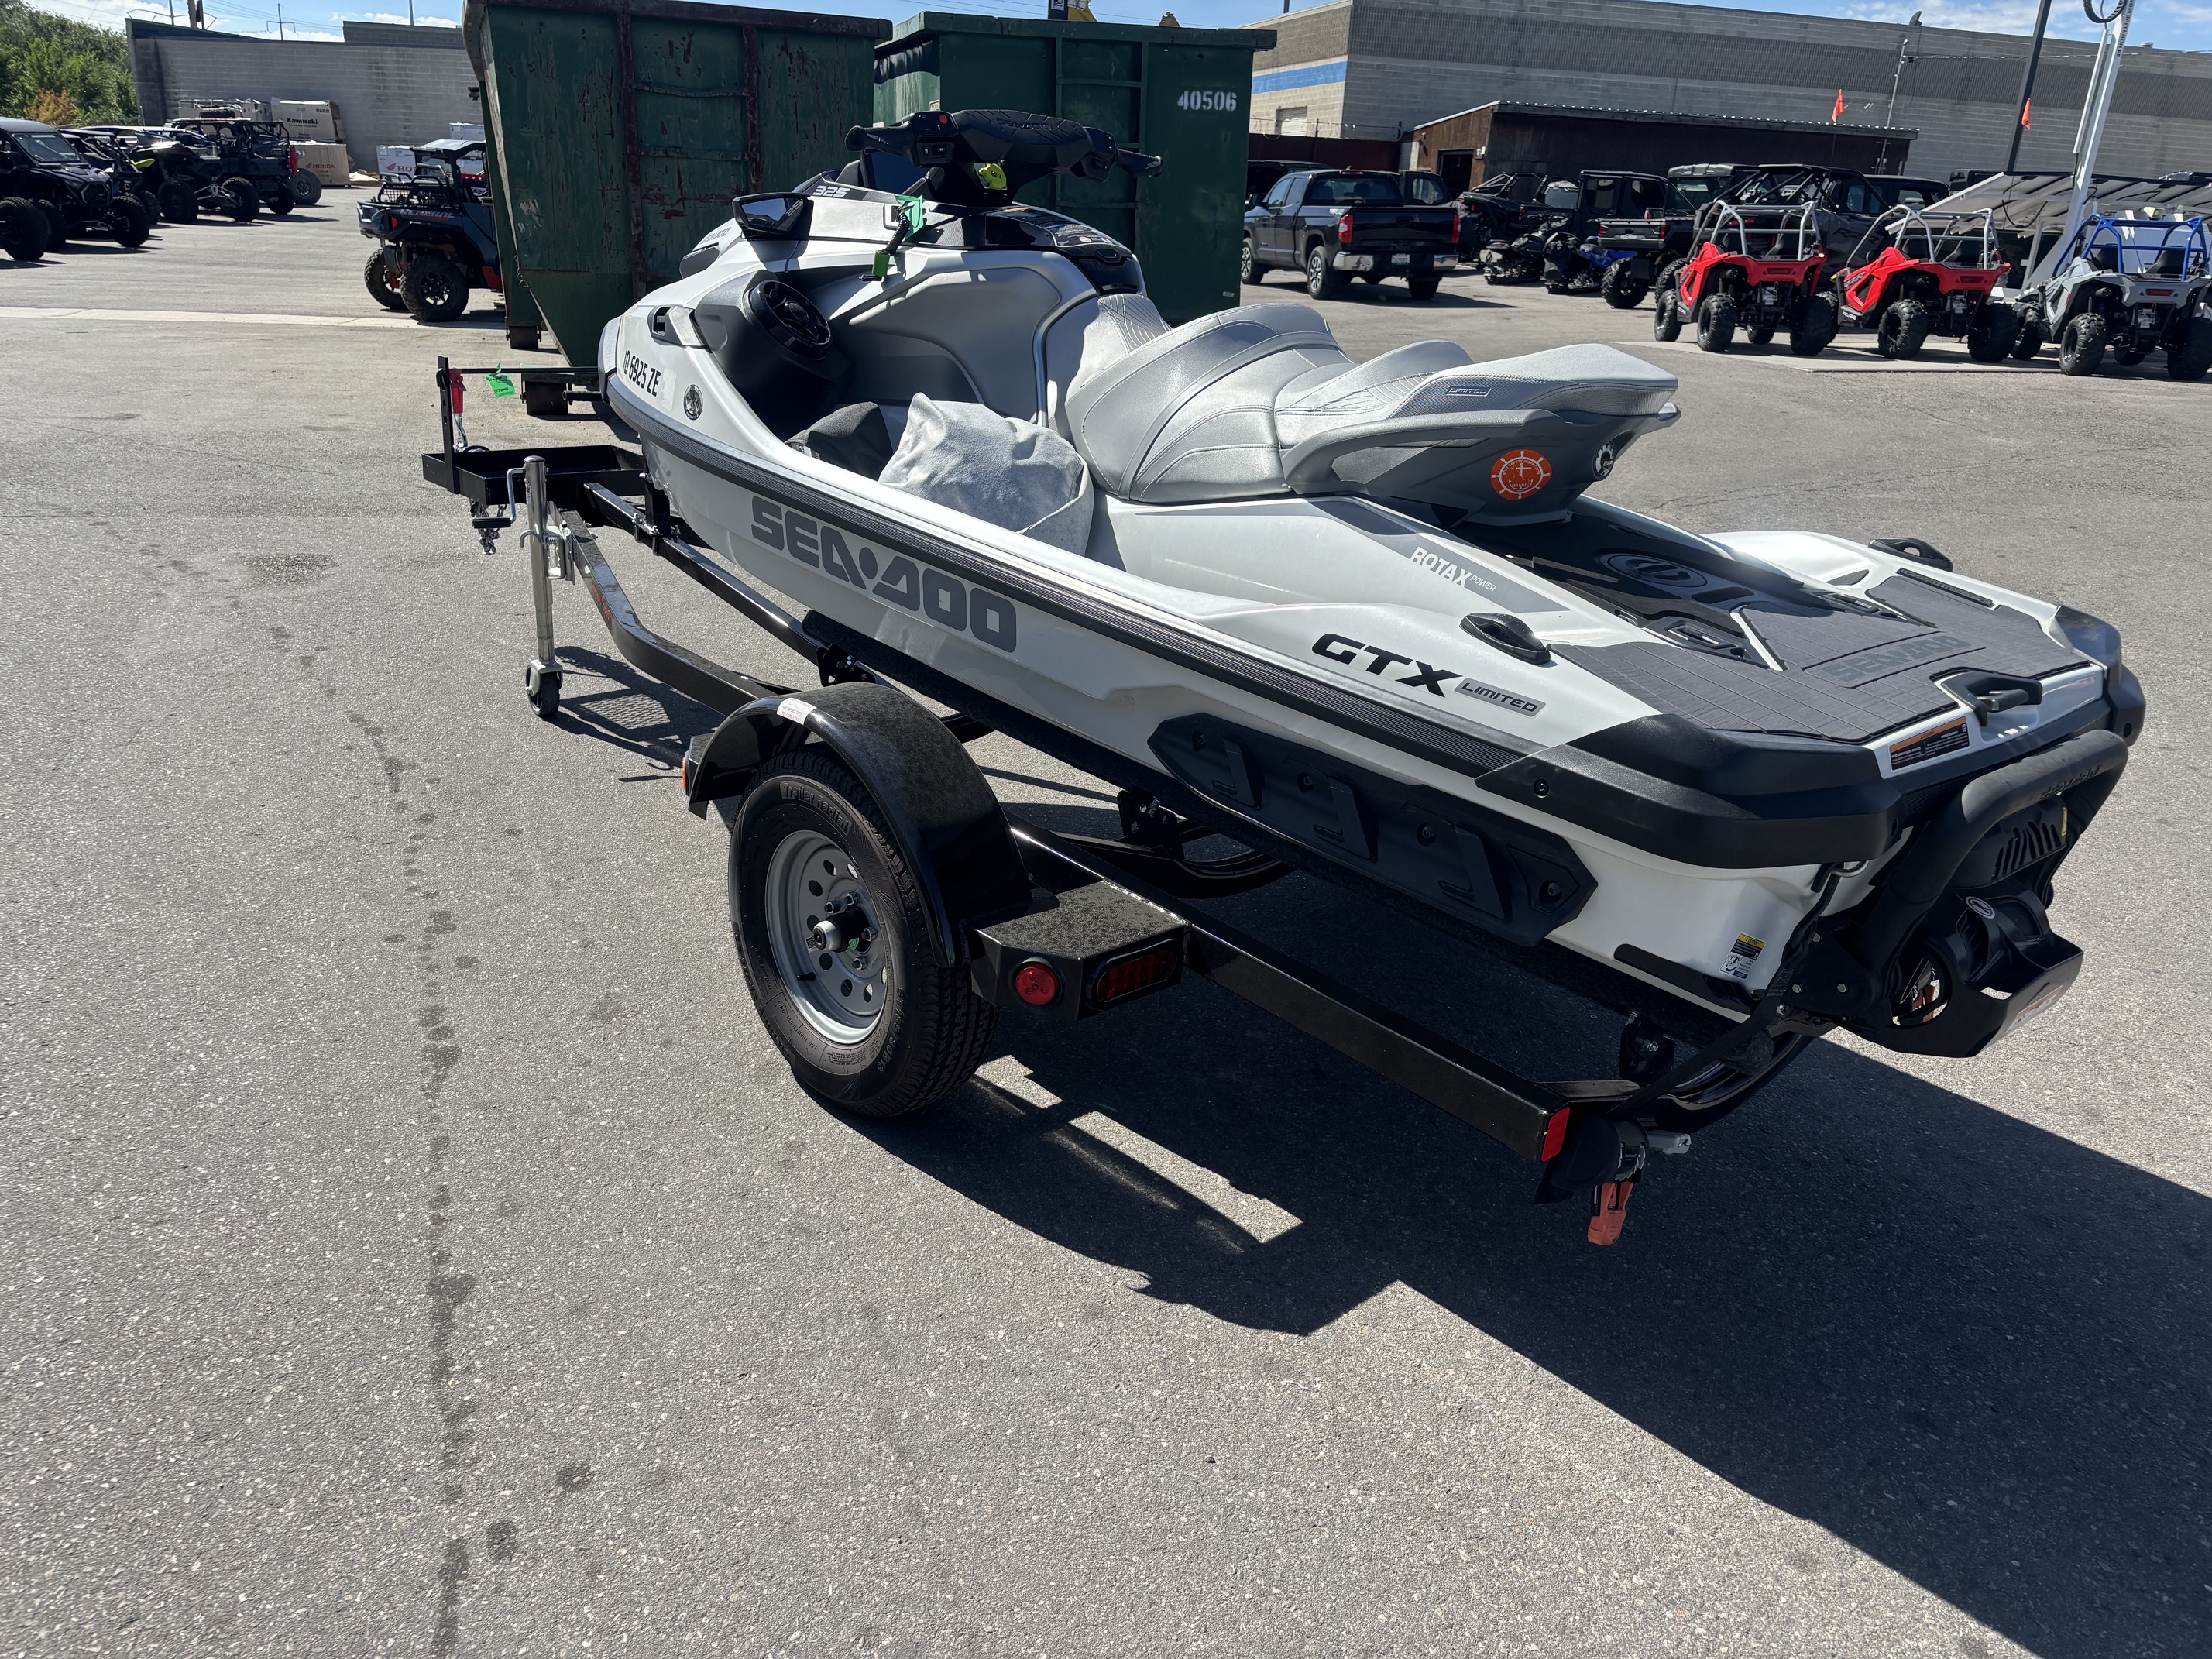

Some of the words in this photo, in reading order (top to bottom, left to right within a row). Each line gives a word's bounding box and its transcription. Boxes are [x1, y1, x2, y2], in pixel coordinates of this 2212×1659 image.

[2119, 29, 2128, 48] HOUR
[1177, 91, 1238, 112] 40506
[812, 185, 851, 198] 325
[399, 208, 455, 218] GENERAL
[623, 349, 630, 375] ID
[629, 355, 648, 390] 6925
[646, 367, 661, 397] ZE
[1523, 459, 1540, 475] INSPECTION
[1410, 546, 1473, 588] ROTAX
[1470, 575, 1497, 592] POWER
[1311, 633, 1463, 698] GTX
[1462, 682, 1538, 713] LIMITED
[783, 784, 816, 805] Trailer
[817, 794, 850, 834] Radial
